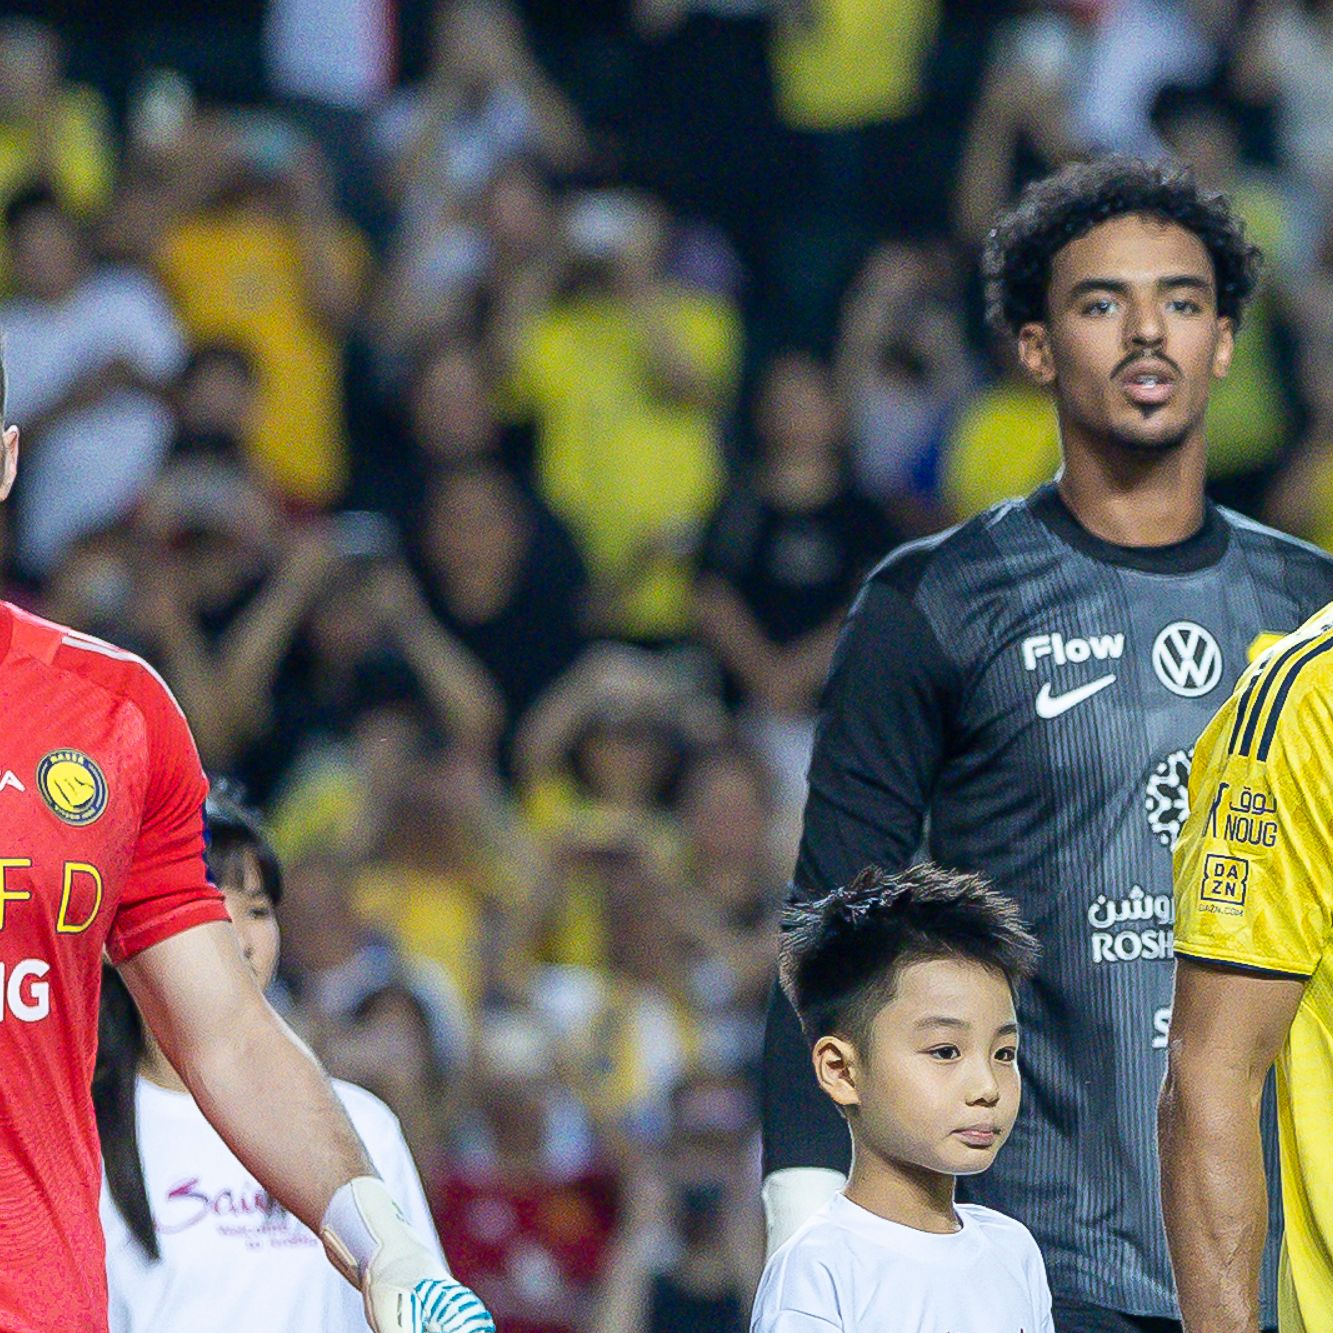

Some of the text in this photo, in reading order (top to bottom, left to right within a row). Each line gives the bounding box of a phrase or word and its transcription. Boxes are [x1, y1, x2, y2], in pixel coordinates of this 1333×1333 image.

[1023, 632, 1126, 671] Flow
[1224, 814, 1278, 848] NOUG
[1092, 929, 1175, 963] ROSH
